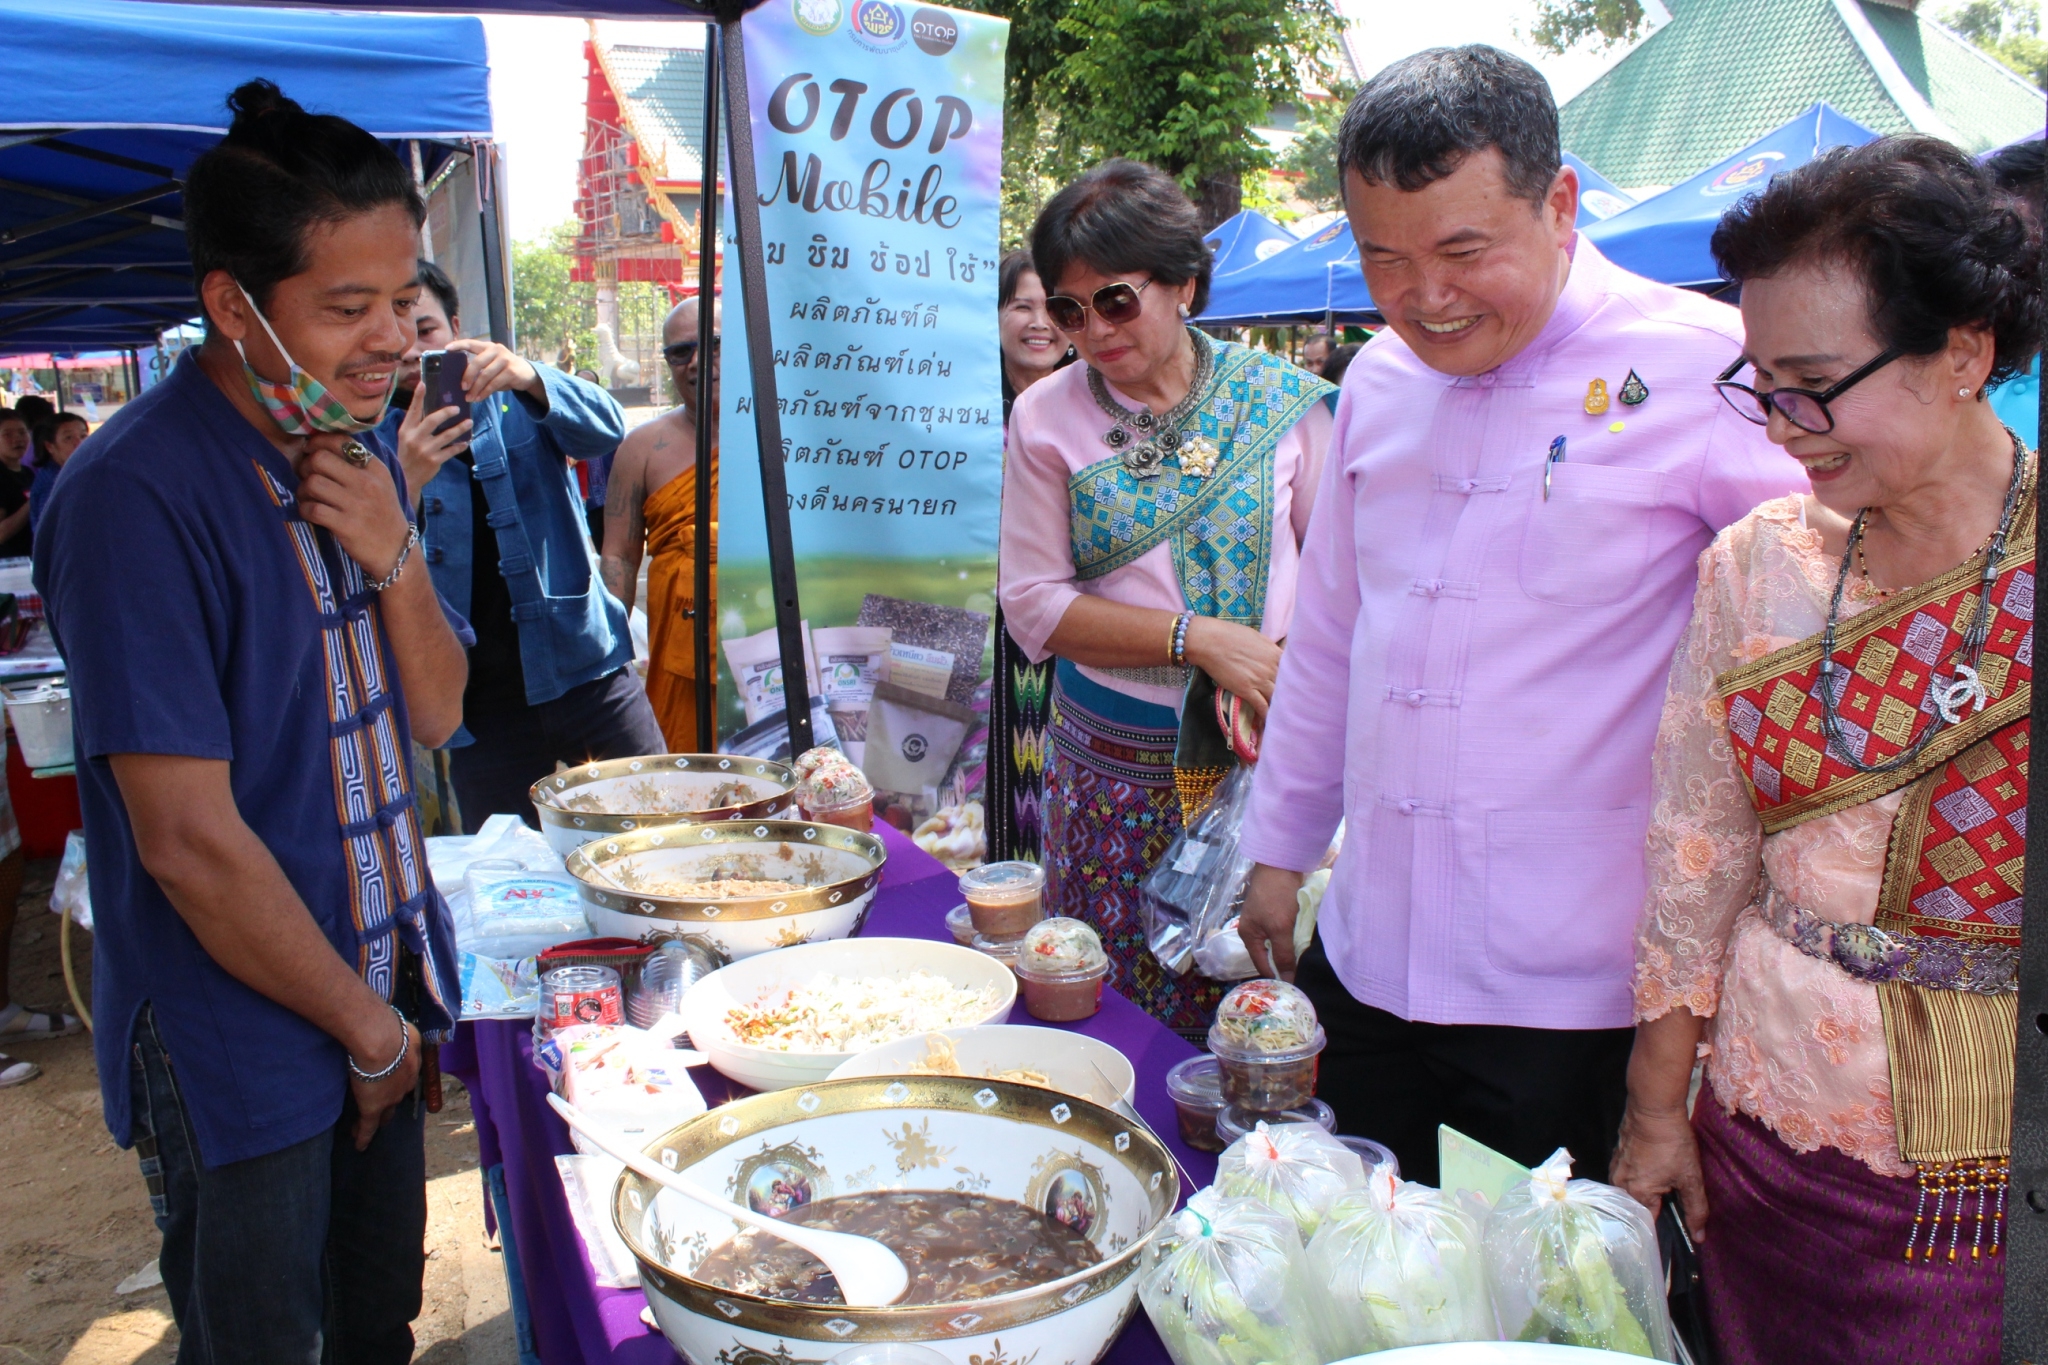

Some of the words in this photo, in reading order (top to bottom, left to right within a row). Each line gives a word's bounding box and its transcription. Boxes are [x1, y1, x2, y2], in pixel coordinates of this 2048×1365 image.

[913, 21, 956, 40] OTOP
[767, 72, 973, 154] OTOP
[757, 150, 962, 229] Mobile
[808, 233, 849, 269] ชิม
[870, 240, 930, 278] ช้อป
[789, 296, 940, 329] ผลิตภัณฑ์ดี
[773, 343, 952, 377] ผลิตภัณฑ์เด่น
[736, 389, 990, 433] ผตภัณฑ์จากชุมชน
[899, 450, 967, 470] OTOP
[503, 887, 556, 901] ABC
